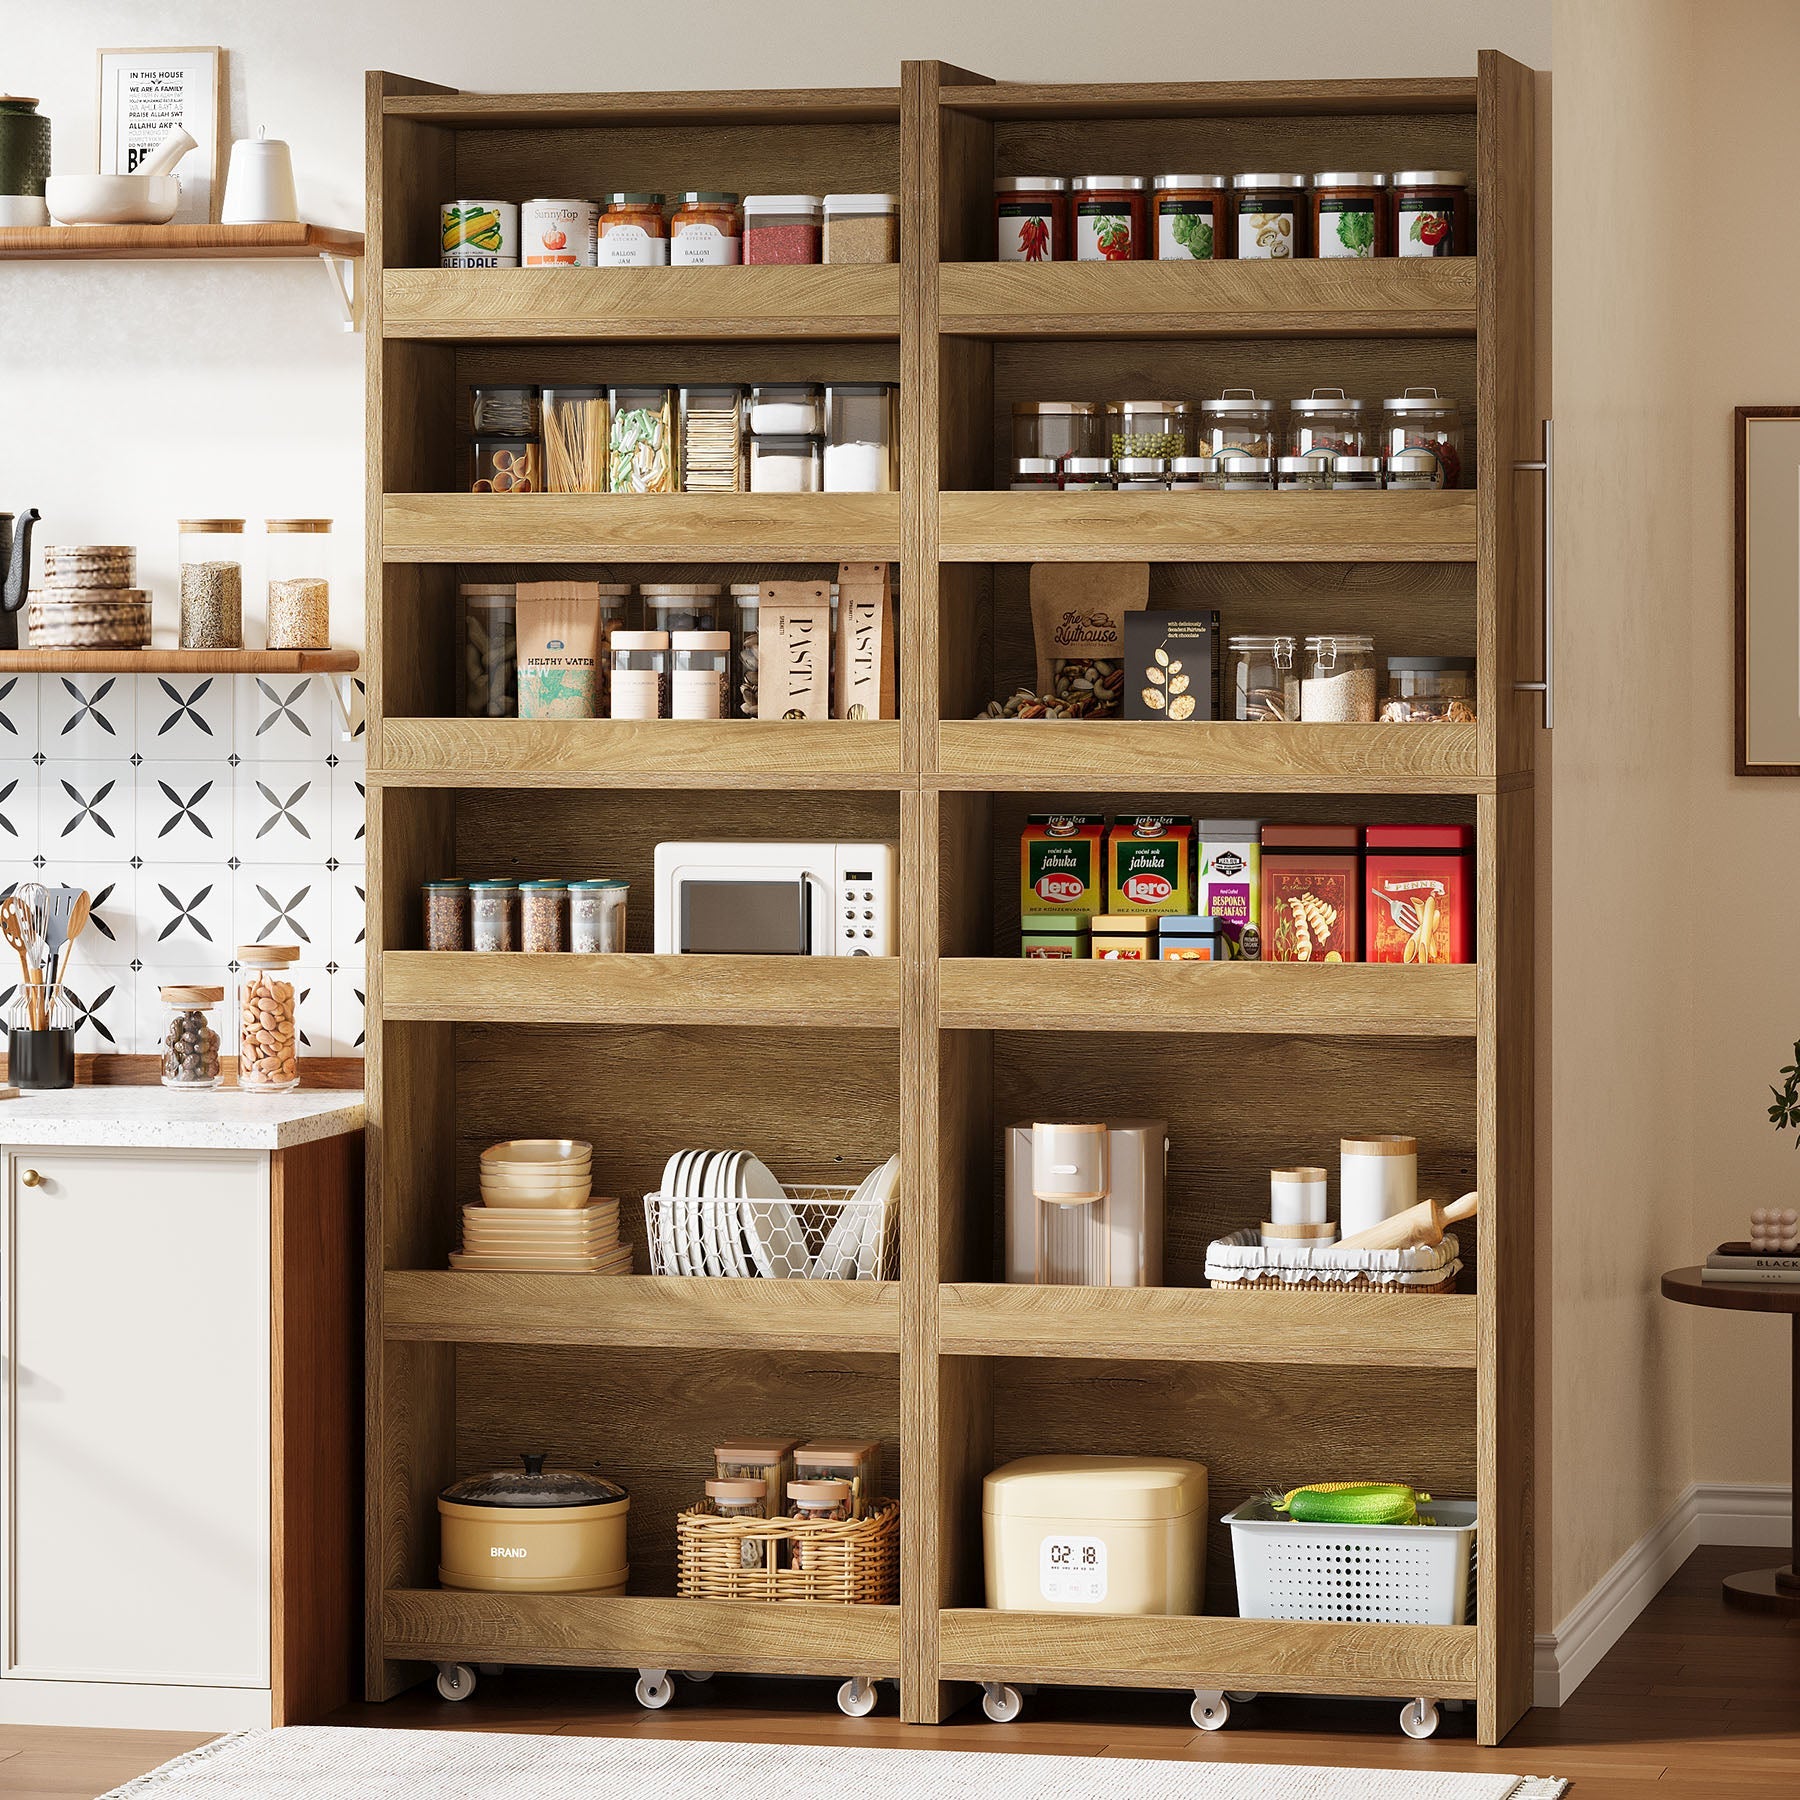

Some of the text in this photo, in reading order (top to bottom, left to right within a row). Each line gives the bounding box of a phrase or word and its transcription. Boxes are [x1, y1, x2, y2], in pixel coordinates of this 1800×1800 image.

[129, 122, 156, 130] ALLAHU
[443, 257, 498, 268] GLENDALE
[1062, 609, 1083, 627] The
[1054, 624, 1118, 646] Nuthouse
[854, 603, 875, 686] PASTA
[565, 658, 595, 666] WATER
[789, 618, 813, 696] PASTA
[1041, 854, 1077, 870] jabuka
[1128, 855, 1165, 871] jabuka
[1282, 876, 1337, 886] PASTA
[1395, 881, 1437, 890] PENNE
[1212, 895, 1246, 906] BESPOKEN
[1211, 906, 1247, 917] BREAKFAST
[1756, 1260, 1799, 1268] BLACK
[490, 1546, 527, 1558] BRAND
